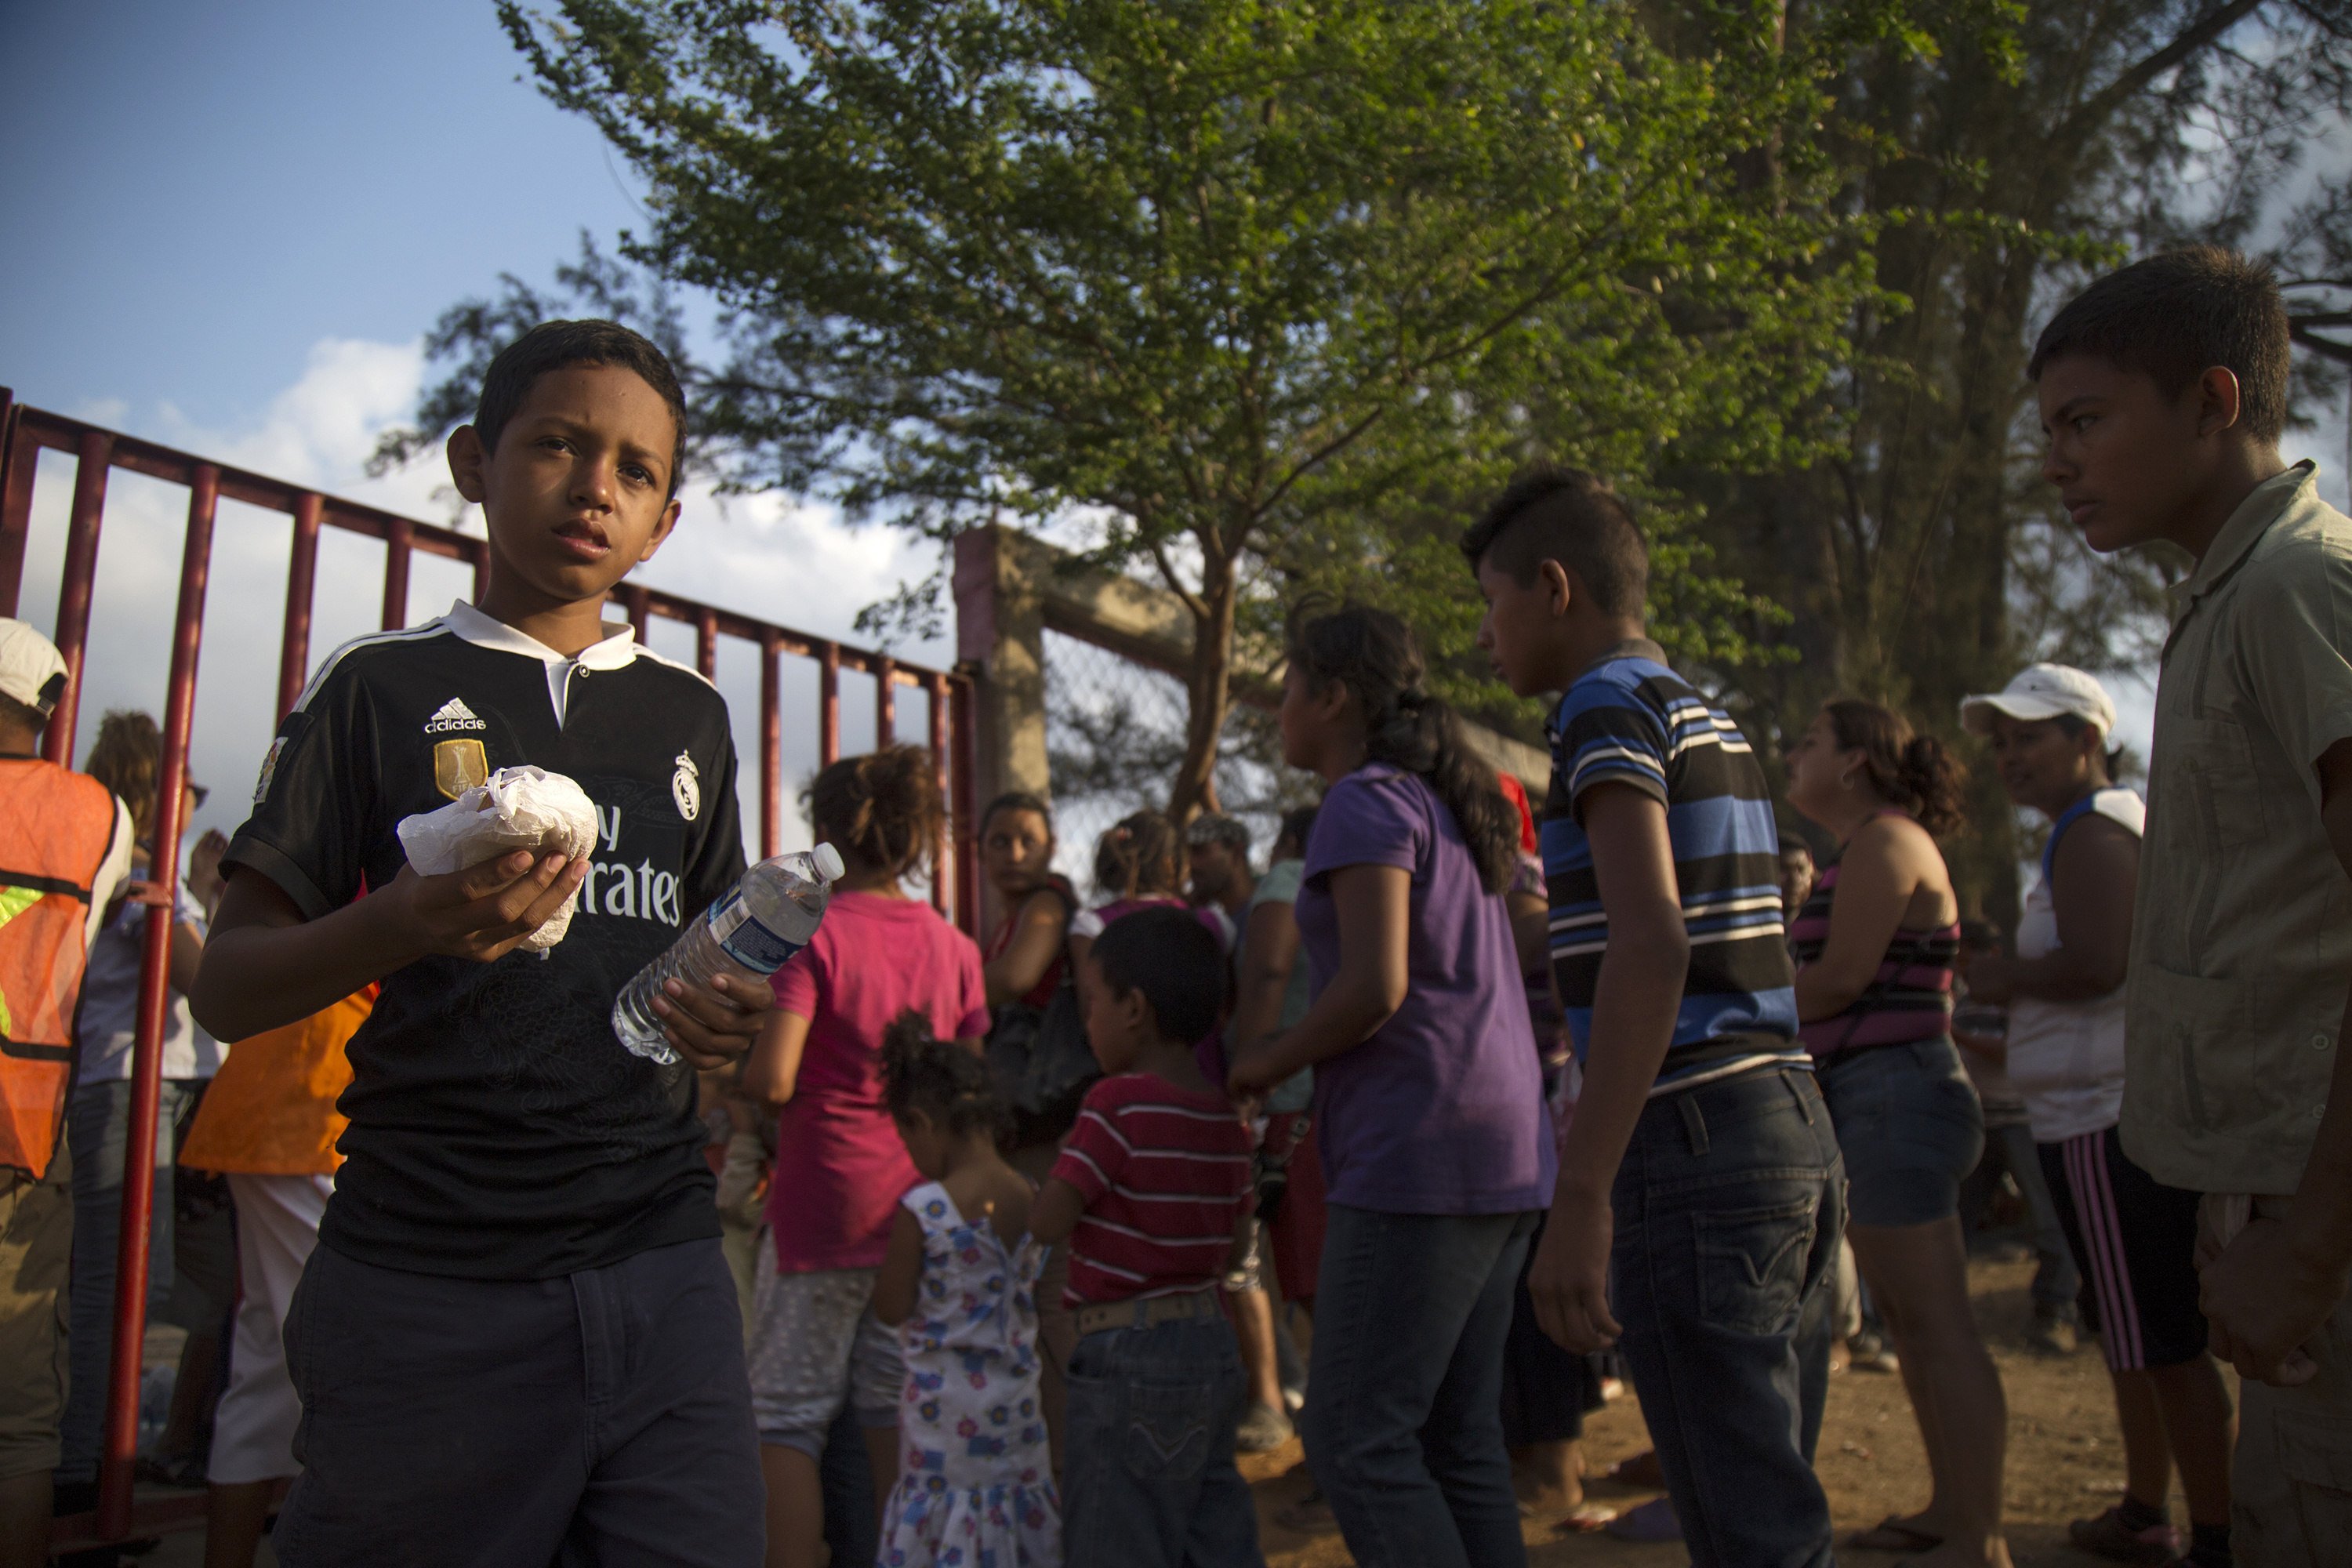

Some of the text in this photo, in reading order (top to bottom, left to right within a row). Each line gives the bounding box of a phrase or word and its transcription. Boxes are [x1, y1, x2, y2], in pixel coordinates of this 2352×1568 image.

[424, 718, 486, 733] adidas
[595, 804, 621, 851] y
[575, 857, 681, 927] rates
